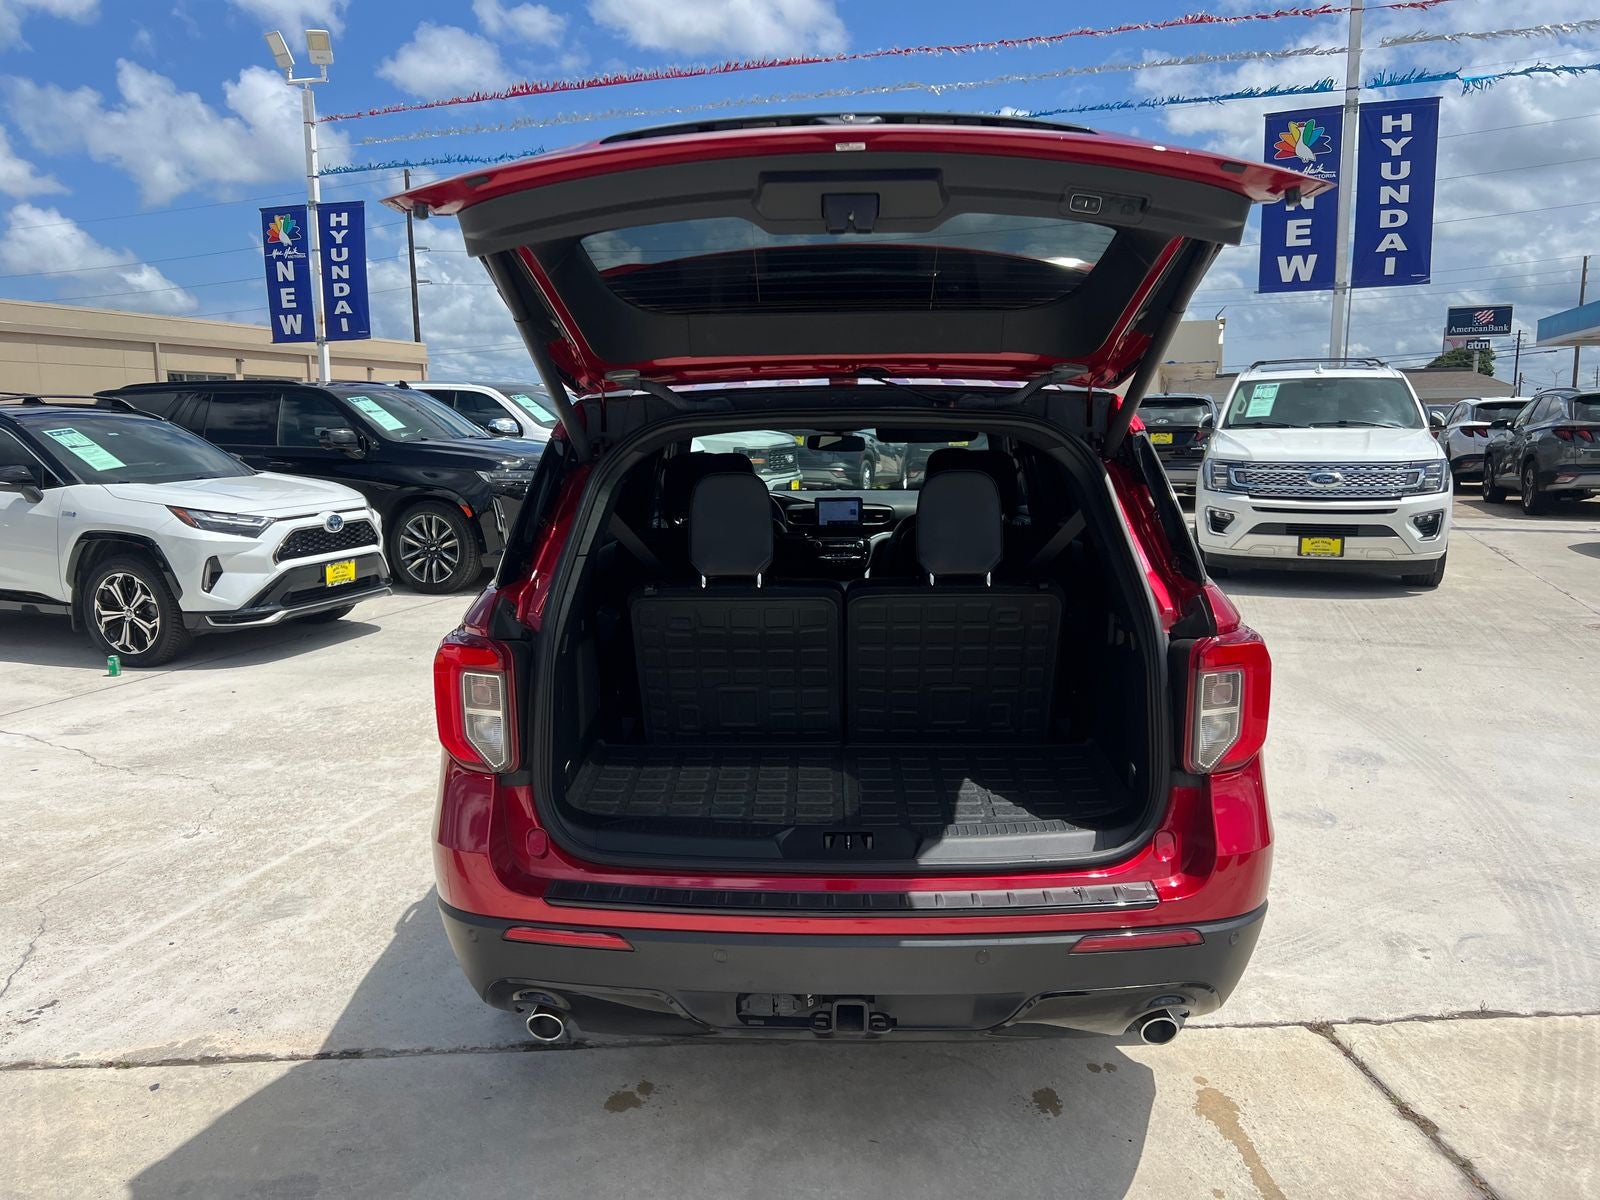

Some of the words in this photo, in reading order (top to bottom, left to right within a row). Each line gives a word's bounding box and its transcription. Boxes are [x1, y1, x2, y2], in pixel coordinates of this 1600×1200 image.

[1375, 113, 1413, 276] HYUNDAI
[276, 260, 303, 335] NEW
[329, 212, 353, 332] HYUNDAI
[1466, 340, 1489, 350] atm
